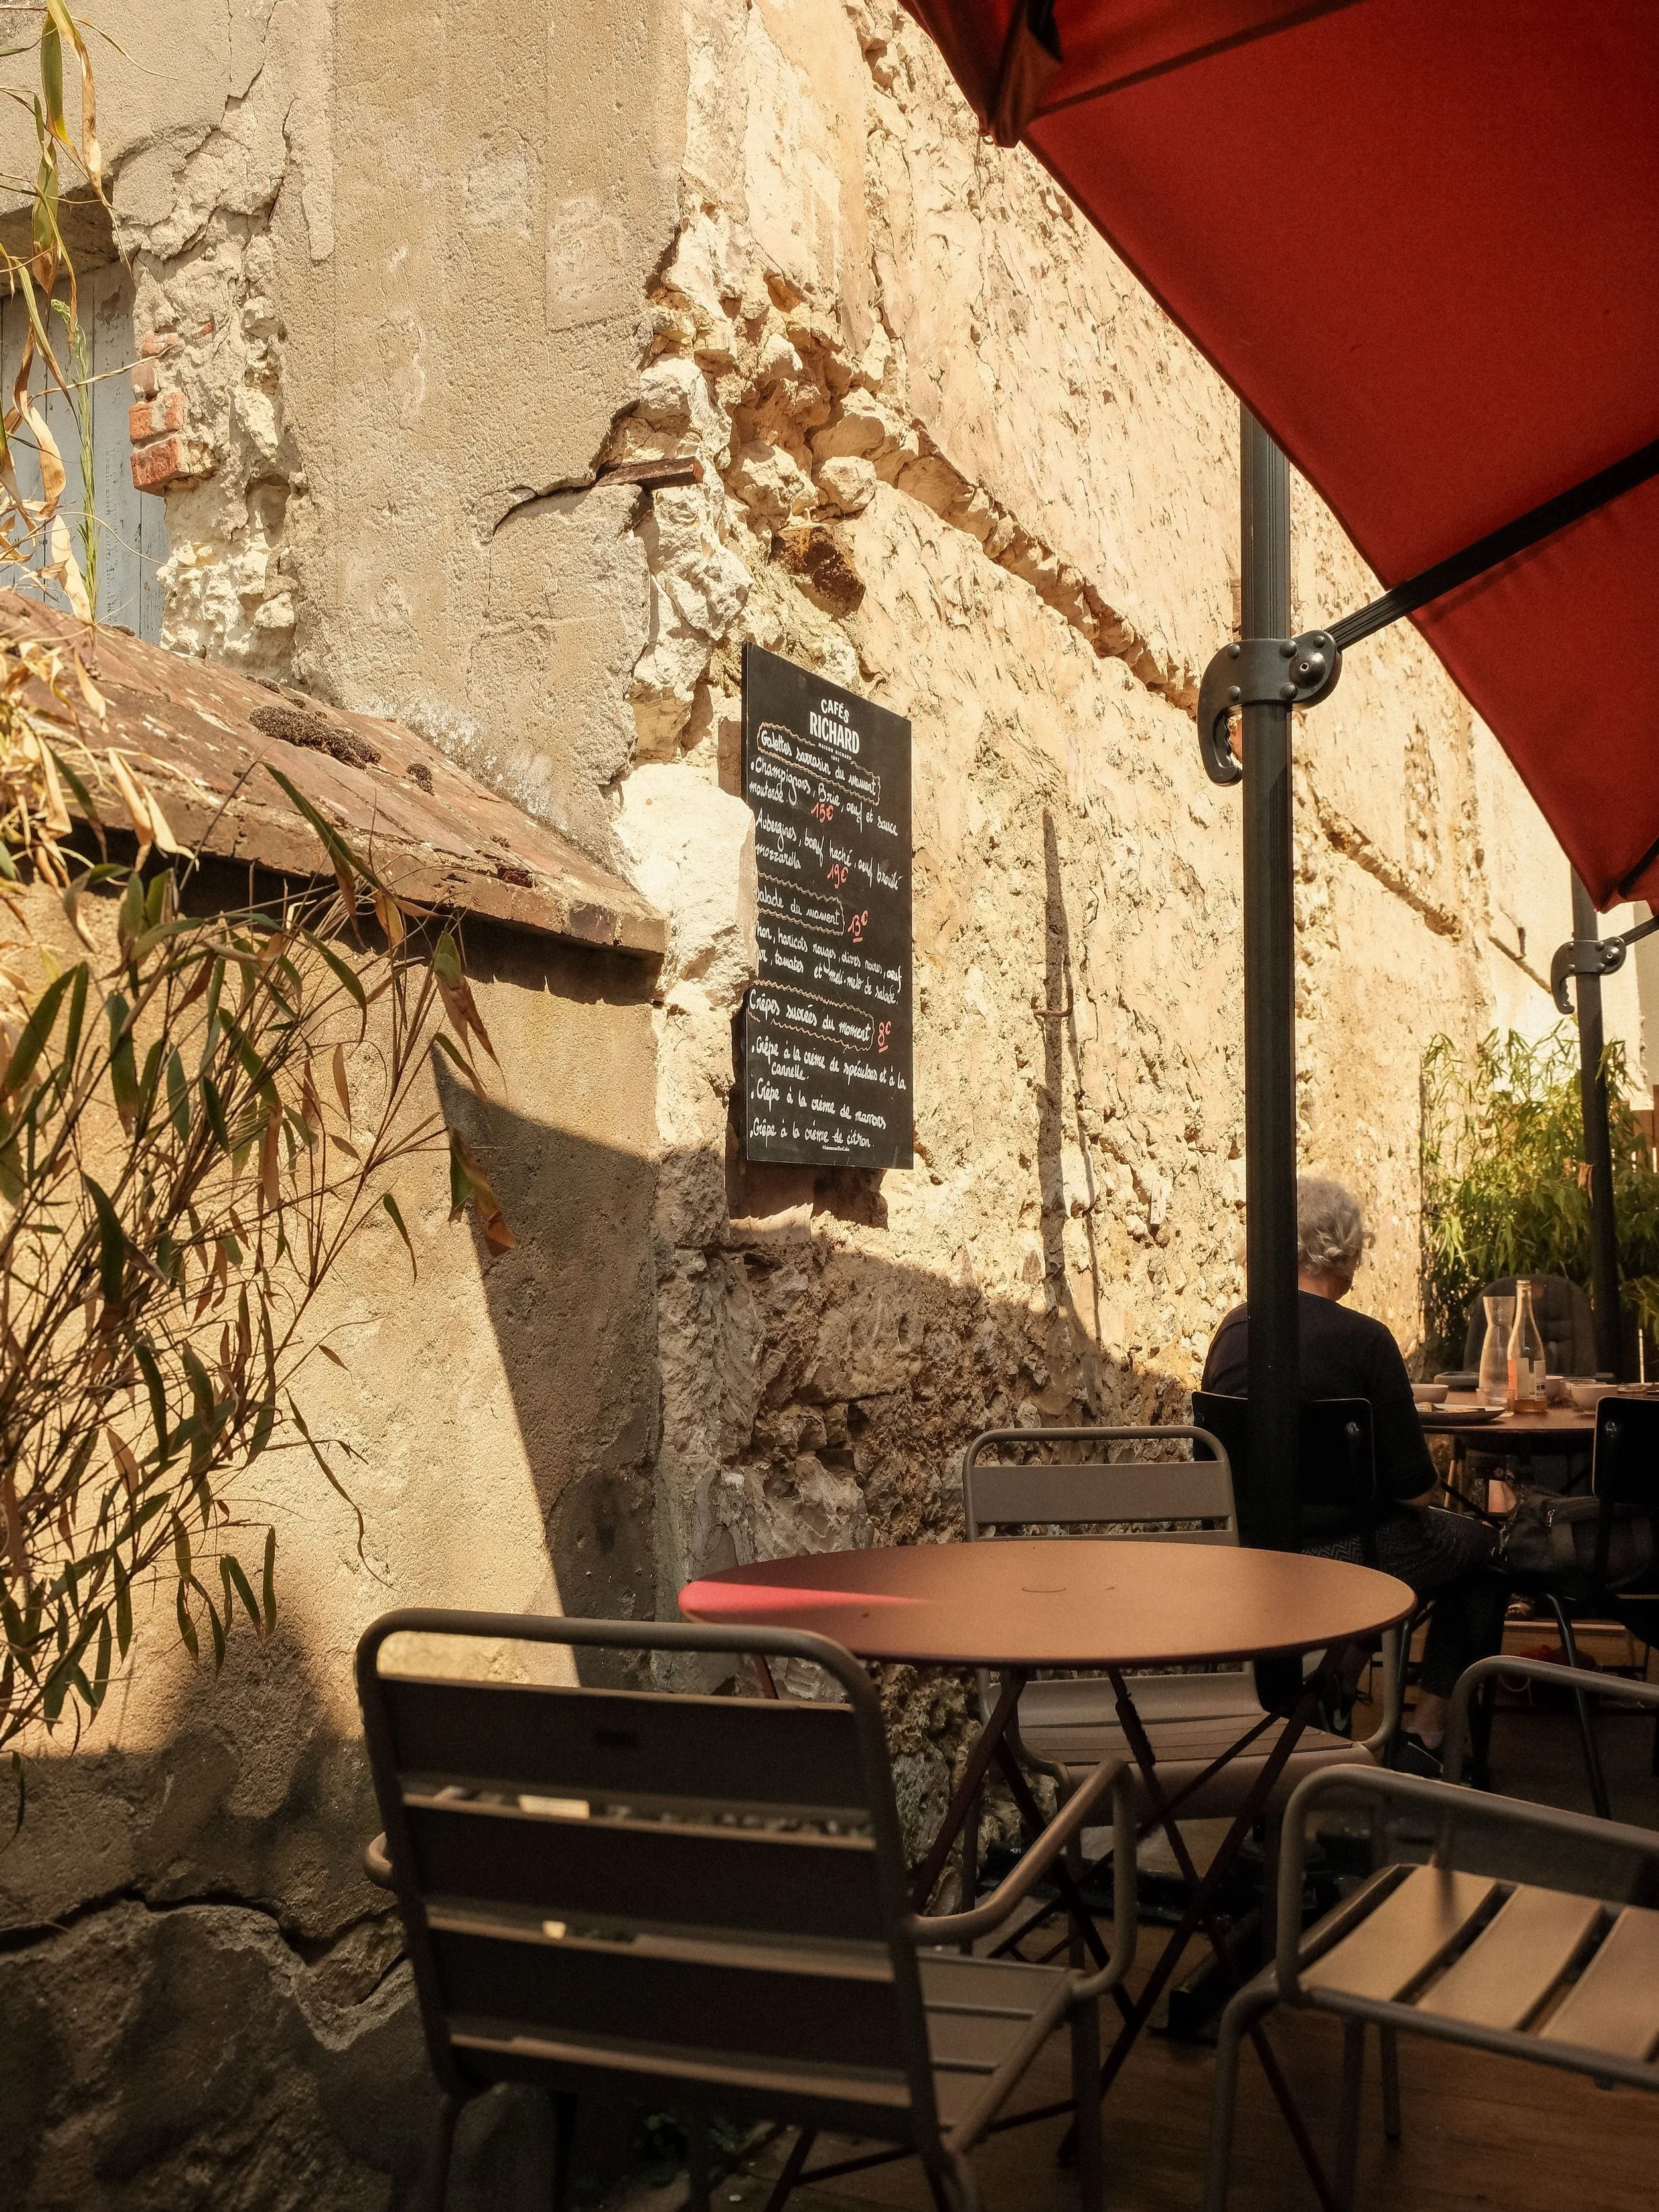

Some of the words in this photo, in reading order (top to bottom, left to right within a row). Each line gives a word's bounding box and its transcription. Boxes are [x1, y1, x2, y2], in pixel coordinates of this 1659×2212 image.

[821, 699, 849, 723] CAFÉS
[810, 711, 860, 754] RICHARD
[761, 730, 792, 757] Galettes
[796, 747, 831, 775] sarrasin
[835, 765, 845, 780] du
[848, 774, 876, 796] moment
[818, 742, 833, 753] MAISON
[835, 749, 852, 761] RICHARD
[811, 802, 834, 823] 15€
[866, 808, 873, 823] et
[877, 816, 898, 836] sauce
[755, 843, 802, 869] mozzarella
[827, 863, 849, 889] 19€
[877, 863, 904, 891] brouillé
[790, 898, 802, 915] du
[806, 908, 840, 925] moment
[778, 926, 808, 952] haricots
[841, 951, 861, 968] olives
[774, 949, 804, 974] tomates
[814, 962, 823, 979] et
[864, 976, 873, 995] de
[749, 988, 780, 1020] Crêpes
[786, 1003, 818, 1027] sucrées
[822, 1014, 835, 1031] du
[838, 1021, 871, 1042] moment
[756, 1035, 779, 1065] Crêpe
[792, 1045, 802, 1062] la
[829, 1056, 839, 1072] de
[843, 1060, 877, 1086] spéculoos
[879, 1067, 887, 1084] et
[897, 1071, 907, 1090] la
[757, 1077, 780, 1112] Crêpe
[798, 1089, 808, 1107] la
[839, 1103, 852, 1120] de
[855, 1110, 887, 1130] marrons
[753, 1117, 777, 1148] Crêpe
[792, 1120, 800, 1139] la
[831, 1127, 844, 1144] de
